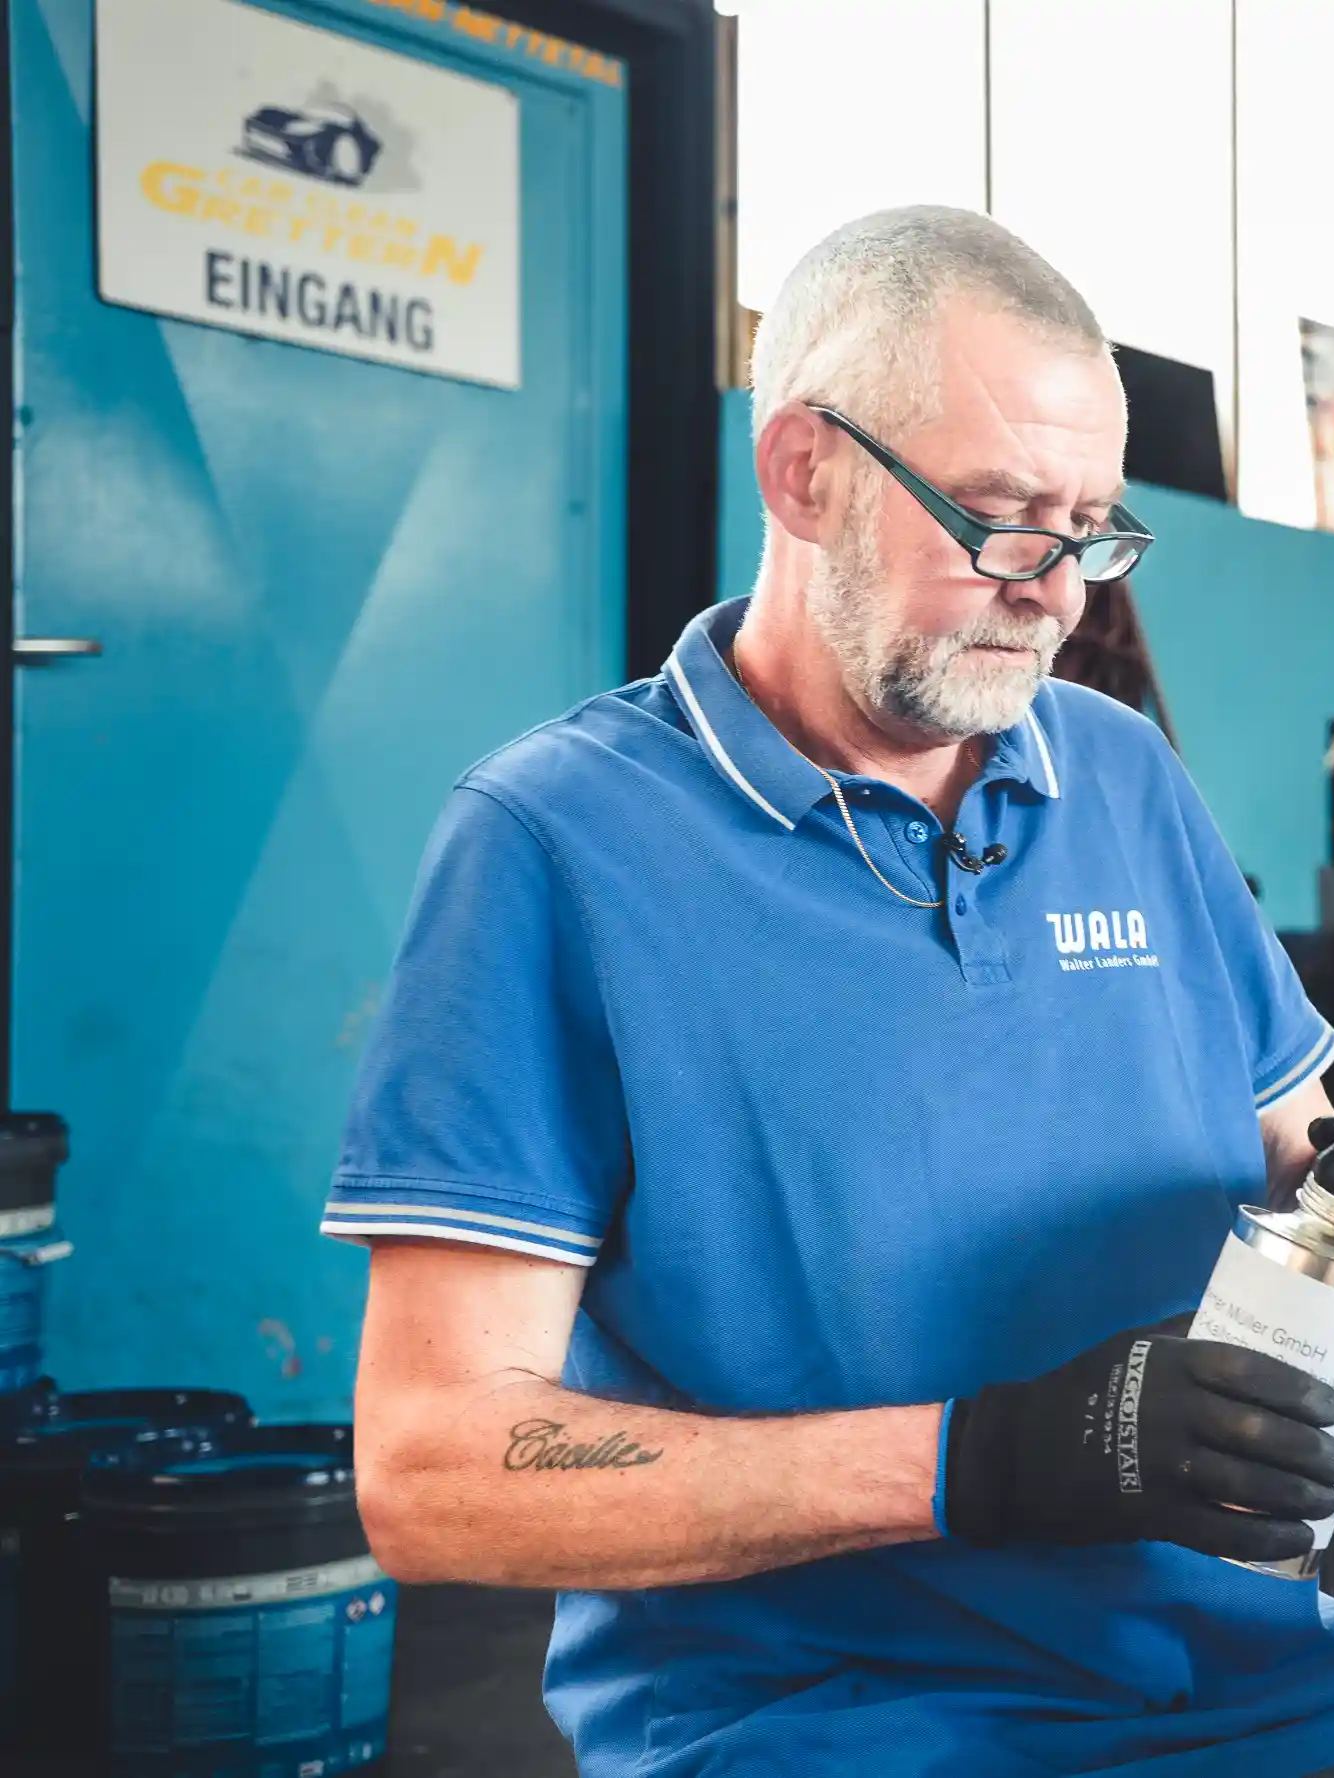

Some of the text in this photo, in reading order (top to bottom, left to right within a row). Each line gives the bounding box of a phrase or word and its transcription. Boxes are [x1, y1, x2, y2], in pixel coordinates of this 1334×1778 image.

[205, 248, 434, 352] EINGANG
[1046, 909, 1148, 954] WALA
[1059, 957, 1094, 972] Walter
[1095, 955, 1132, 970] Landers
[1272, 1327, 1328, 1363] GmbH
[1117, 1341, 1152, 1492] HYGOSTAR
